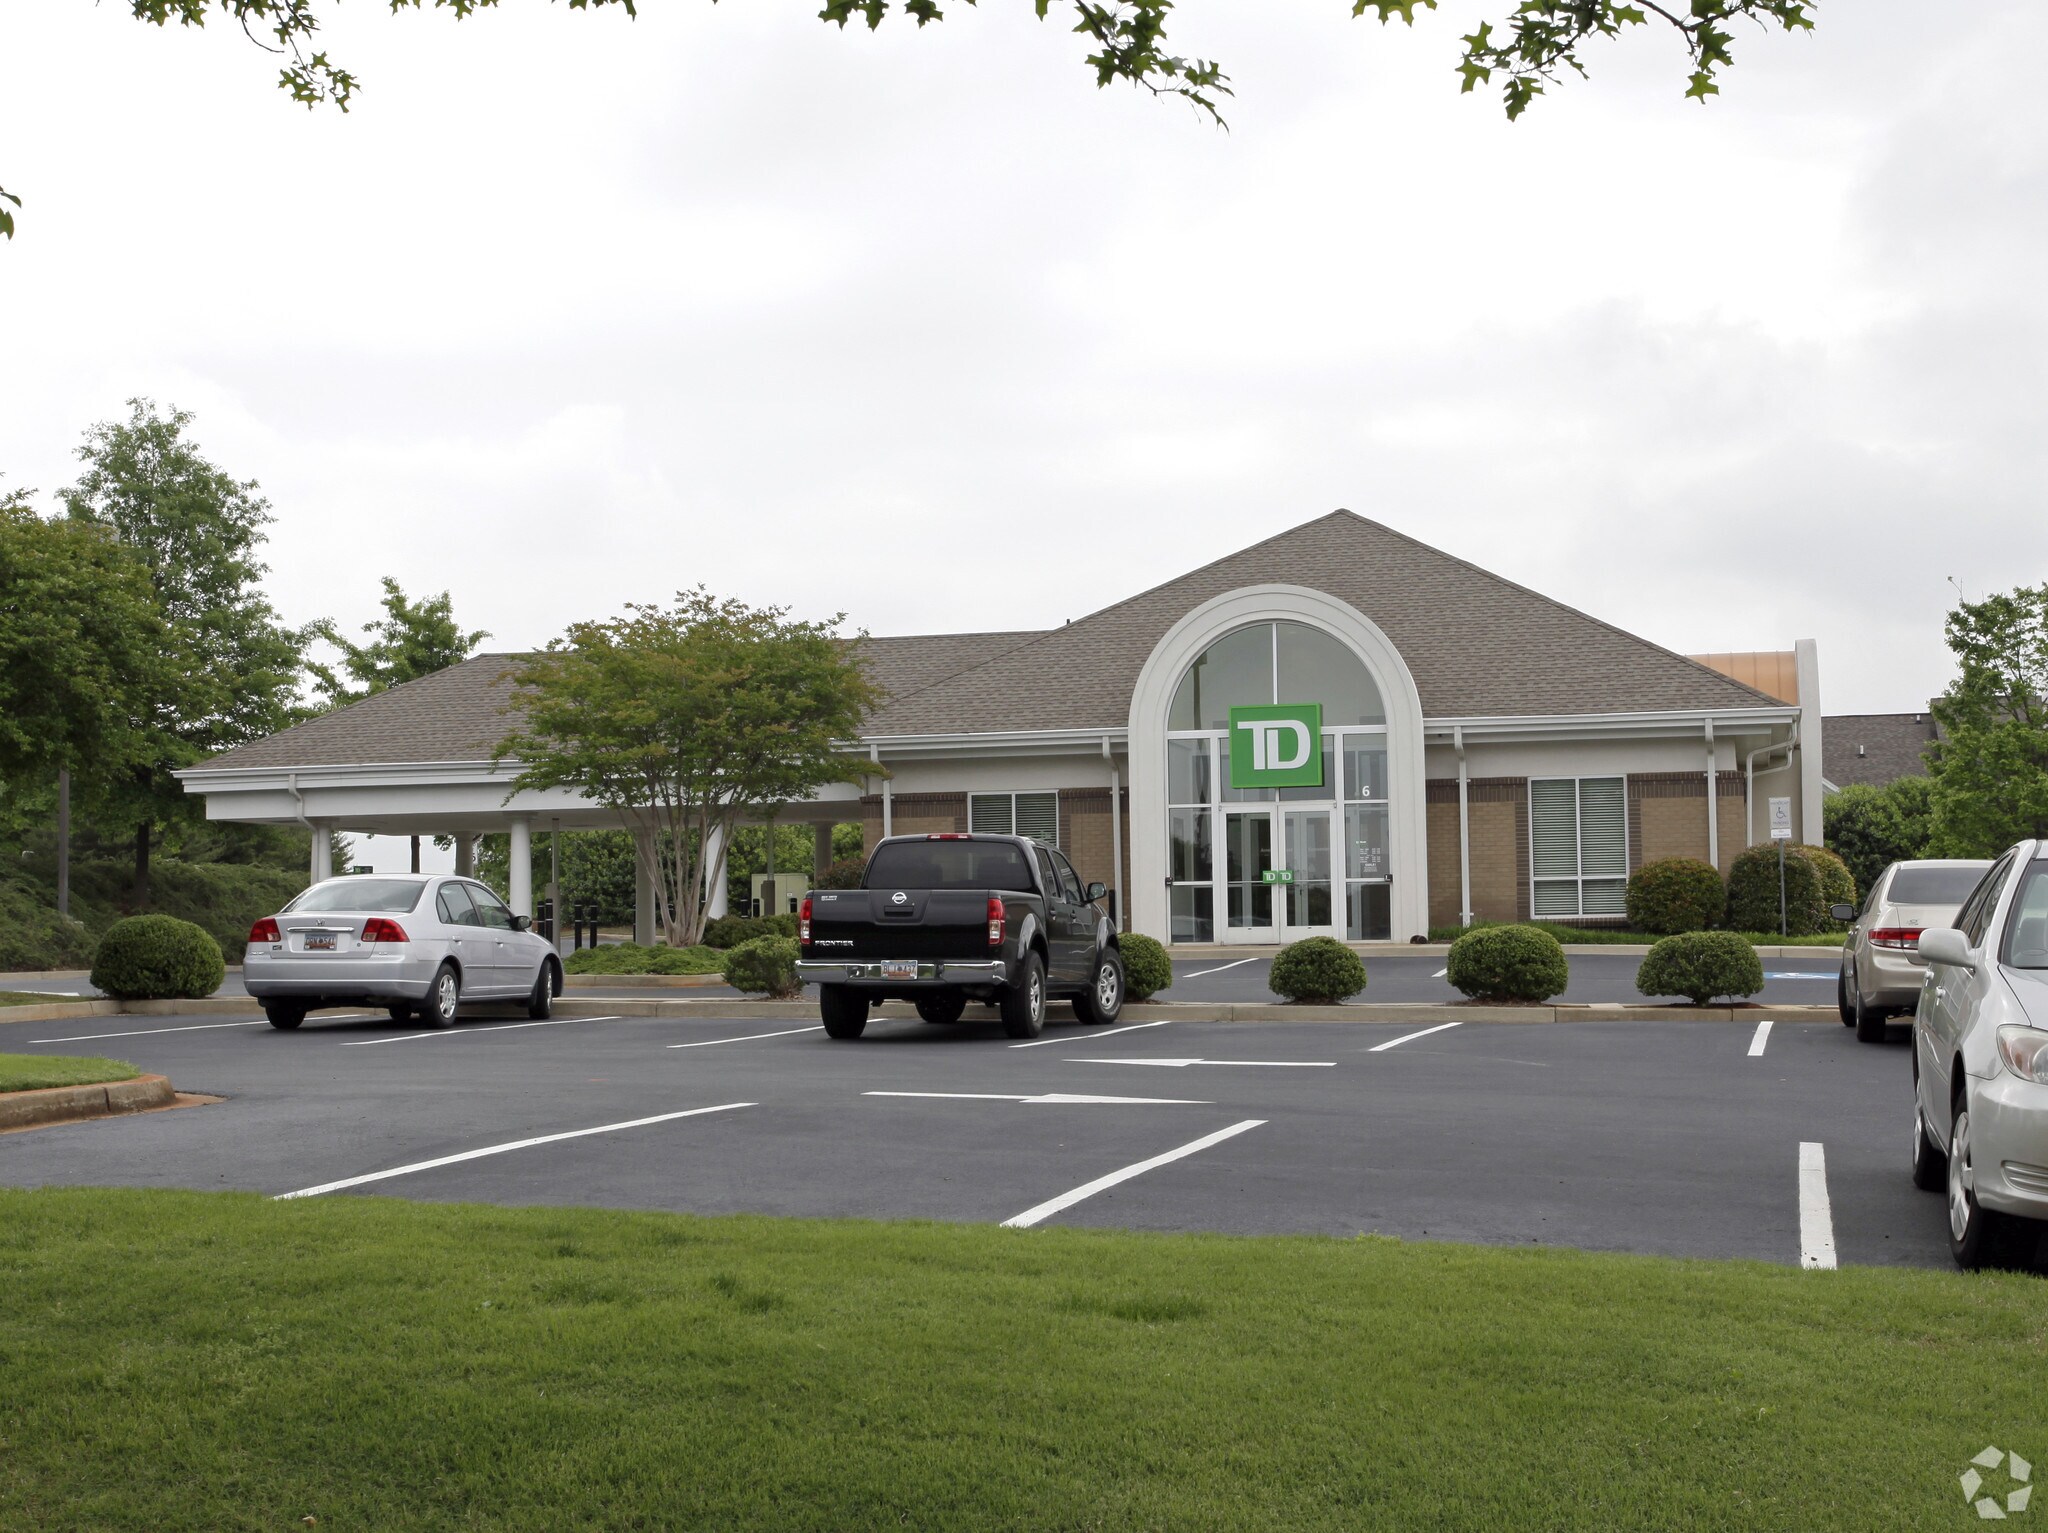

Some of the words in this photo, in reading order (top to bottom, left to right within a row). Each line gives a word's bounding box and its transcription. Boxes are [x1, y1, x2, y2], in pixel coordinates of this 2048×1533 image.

[1237, 719, 1311, 770] TD
[1362, 785, 1371, 797] 6
[1264, 872, 1276, 881] TD
[1280, 872, 1292, 881] TD
